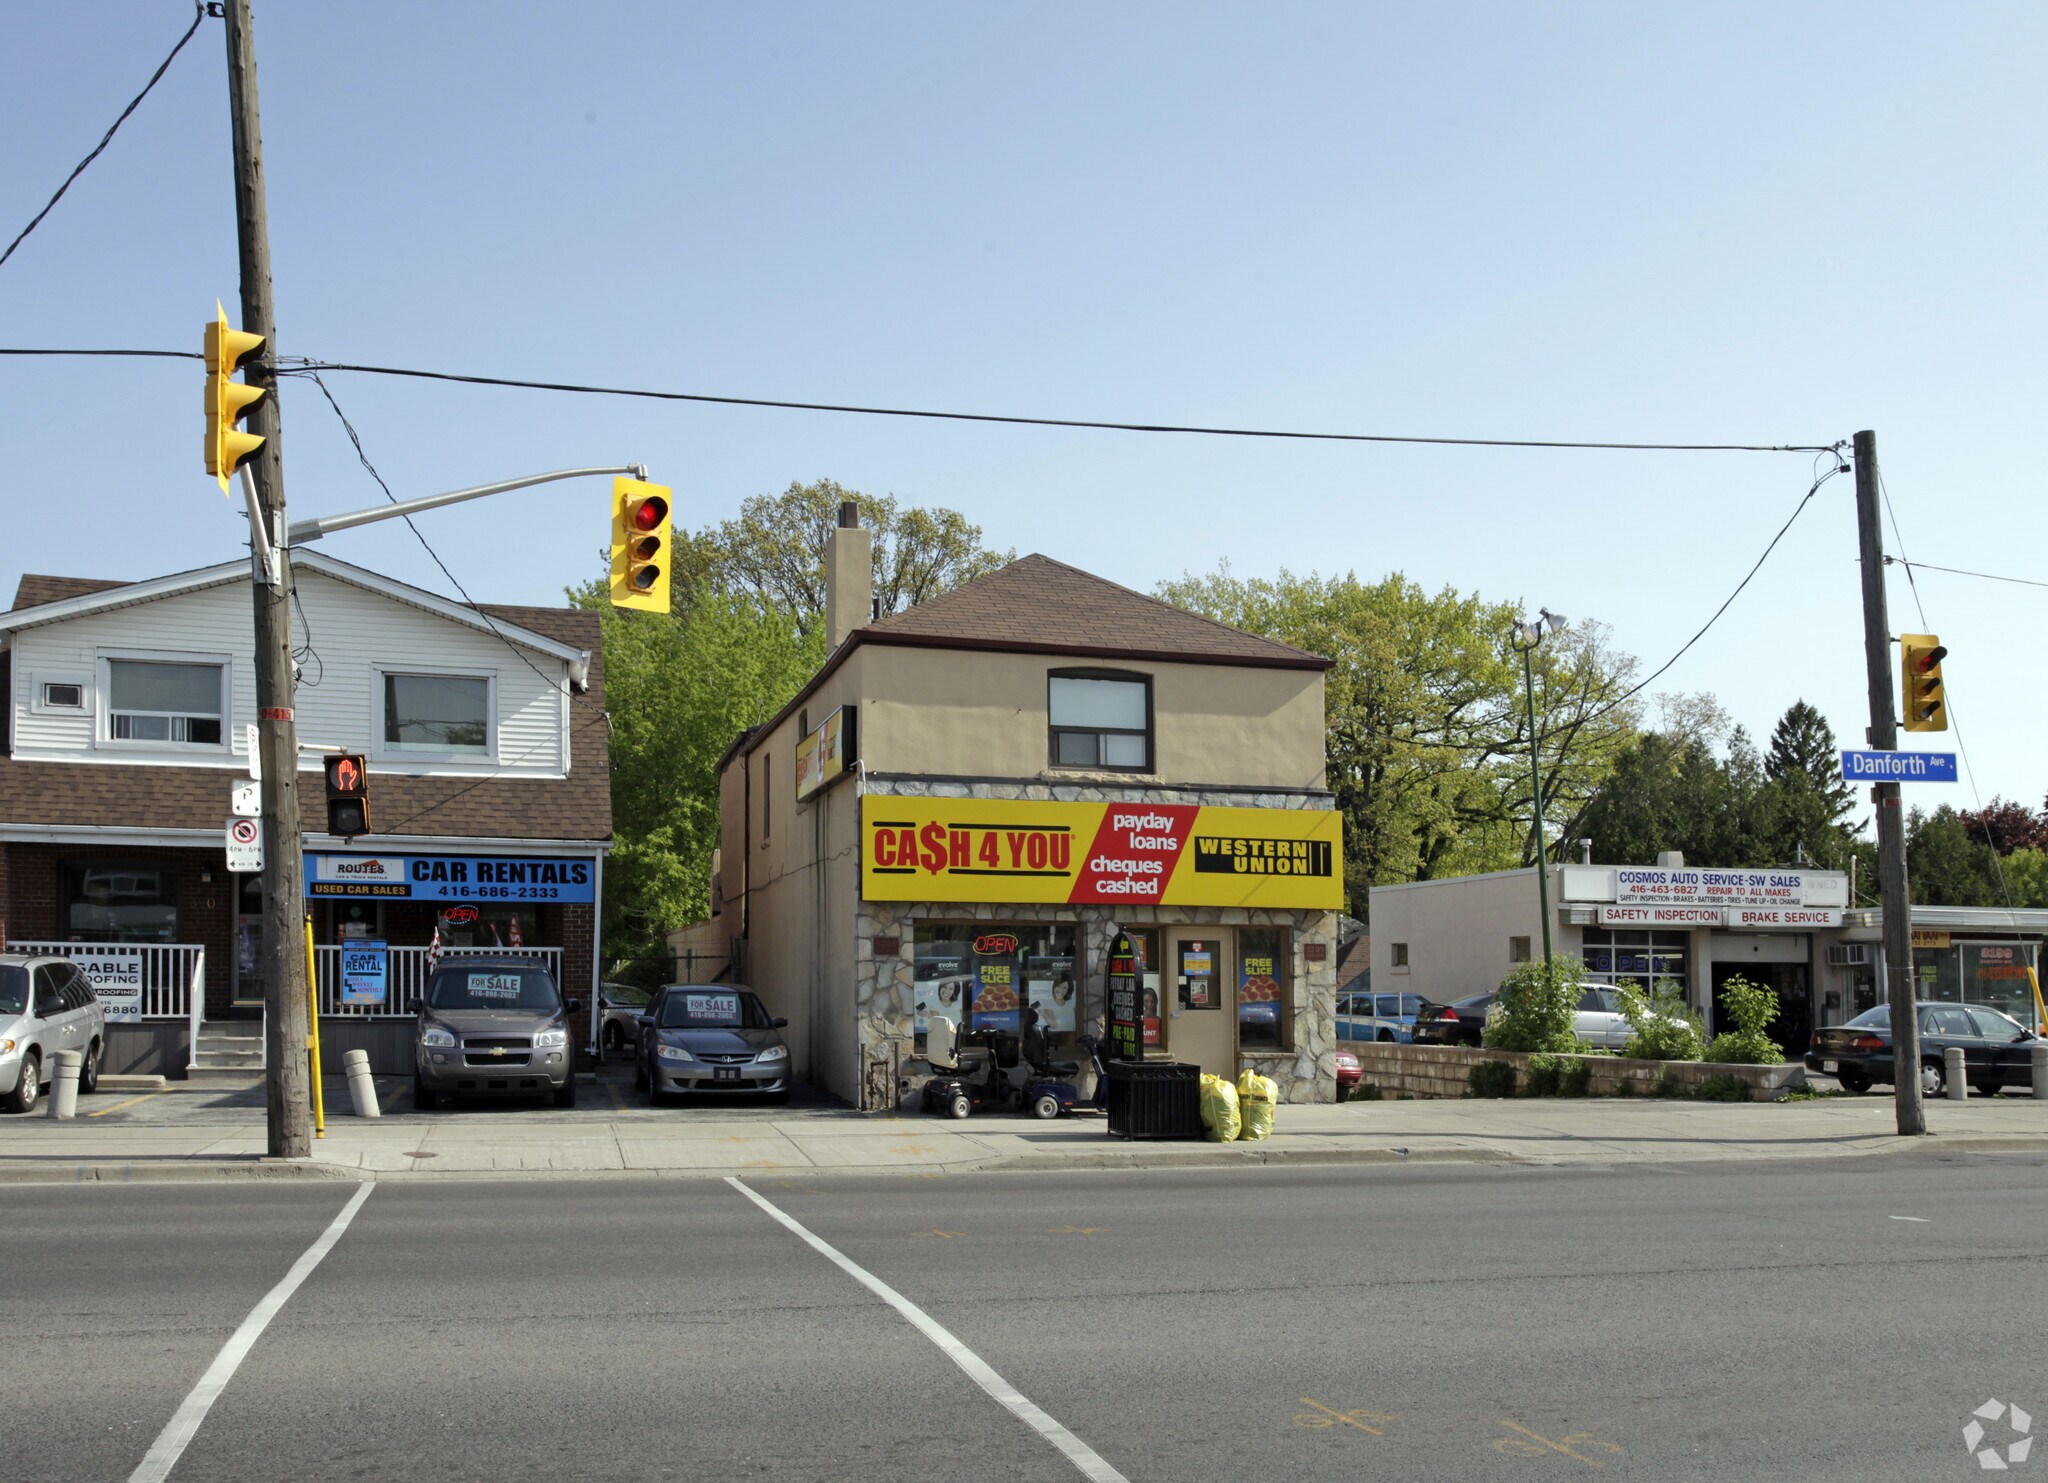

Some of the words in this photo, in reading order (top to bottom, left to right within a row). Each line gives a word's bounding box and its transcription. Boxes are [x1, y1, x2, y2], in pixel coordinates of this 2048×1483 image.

[1853, 753, 1926, 775] Danforth
[1930, 756, 1945, 767] Ave
[1113, 812, 1174, 833] payday
[1129, 832, 1177, 850] loans
[978, 832, 1000, 868] 4
[1006, 832, 1071, 869] YOU
[1199, 838, 1307, 858] WESTERN
[337, 864, 385, 874] ROUTES
[1090, 855, 1163, 876] cheques
[1234, 856, 1307, 874] UNION
[412, 860, 462, 883] CAR
[477, 862, 588, 885] RENTALS
[1096, 876, 1158, 894] cashed
[1619, 871, 1667, 884] COSMOS
[1670, 873, 1699, 885] AUTO
[1770, 876, 1801, 888] SALES
[315, 884, 344, 894] USED
[347, 885, 370, 895] CAR
[372, 885, 406, 895] SALES
[438, 886, 559, 899] 416-686-2333
[1630, 885, 1699, 894] 416-463-6827
[1707, 887, 1733, 895] REPAIR
[1736, 887, 1746, 895] TO
[1750, 888, 1763, 896] ALL
[1765, 888, 1792, 897] MAKES
[1697, 896, 1724, 904] BATTERIES
[1779, 898, 1801, 906] CHANGE
[444, 908, 480, 921] OPEN
[1607, 909, 1649, 920] SAFETY
[1654, 910, 1719, 921] INSPECTION
[1741, 912, 1779, 922] BRAKE
[1784, 912, 1830, 923] SERVICE
[975, 936, 1016, 953] OPEN
[345, 961, 382, 971] RENTAL
[1245, 958, 1273, 967] FREE
[1596, 955, 1666, 971] OPEN
[980, 965, 1010, 975] FREE
[1245, 967, 1273, 976] SLICE
[471, 979, 485, 989] FOR
[487, 977, 518, 990] SALE
[980, 974, 1011, 984] SLICE
[705, 999, 734, 1012] SALE
